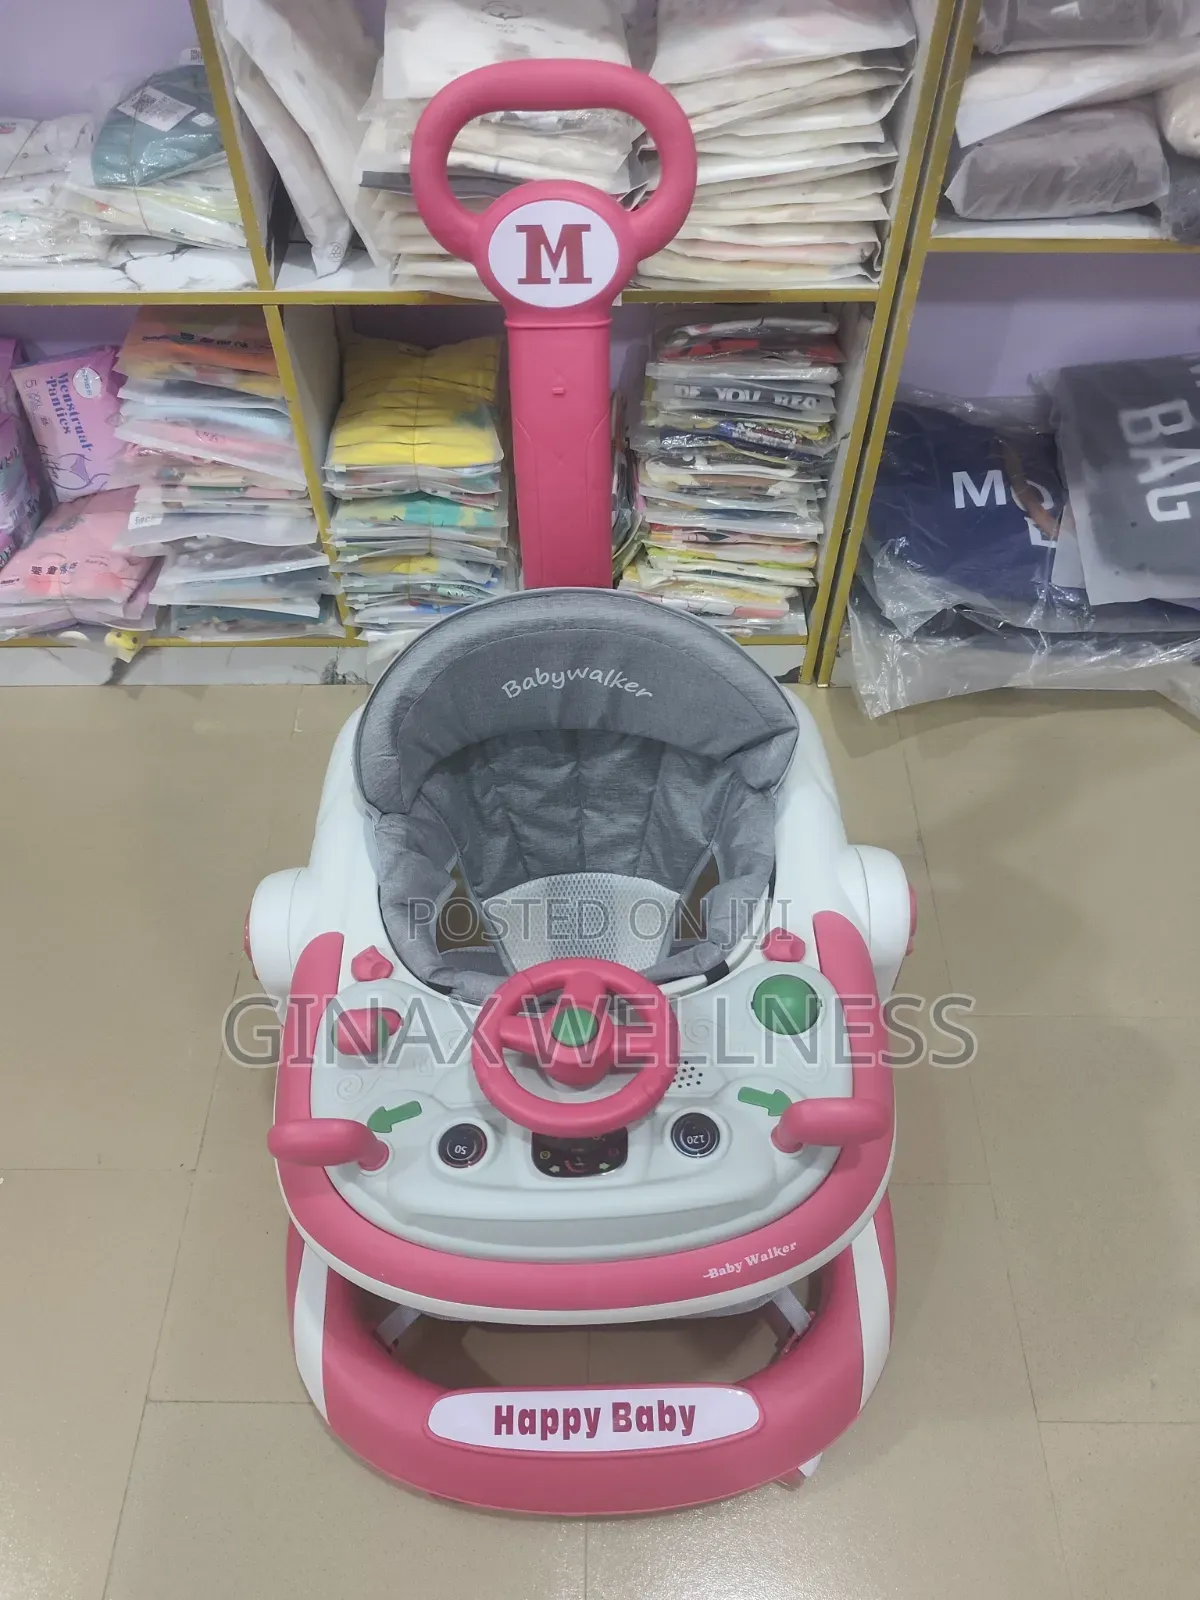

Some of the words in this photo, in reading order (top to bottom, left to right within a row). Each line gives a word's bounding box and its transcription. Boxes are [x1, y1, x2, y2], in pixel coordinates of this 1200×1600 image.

[515, 223, 592, 284] M
[46, 376, 70, 434] Panties
[58, 372, 92, 451] Menstrual
[713, 387, 763, 403] YOU
[1119, 398, 1200, 523] BAG
[501, 667, 653, 698] Babywalker
[454, 1144, 468, 1155] 50
[686, 1134, 706, 1145] 120
[703, 1261, 742, 1279] Baby
[744, 1241, 797, 1267] Walker
[494, 1404, 601, 1440] Happy
[612, 1400, 696, 1437] Baby
